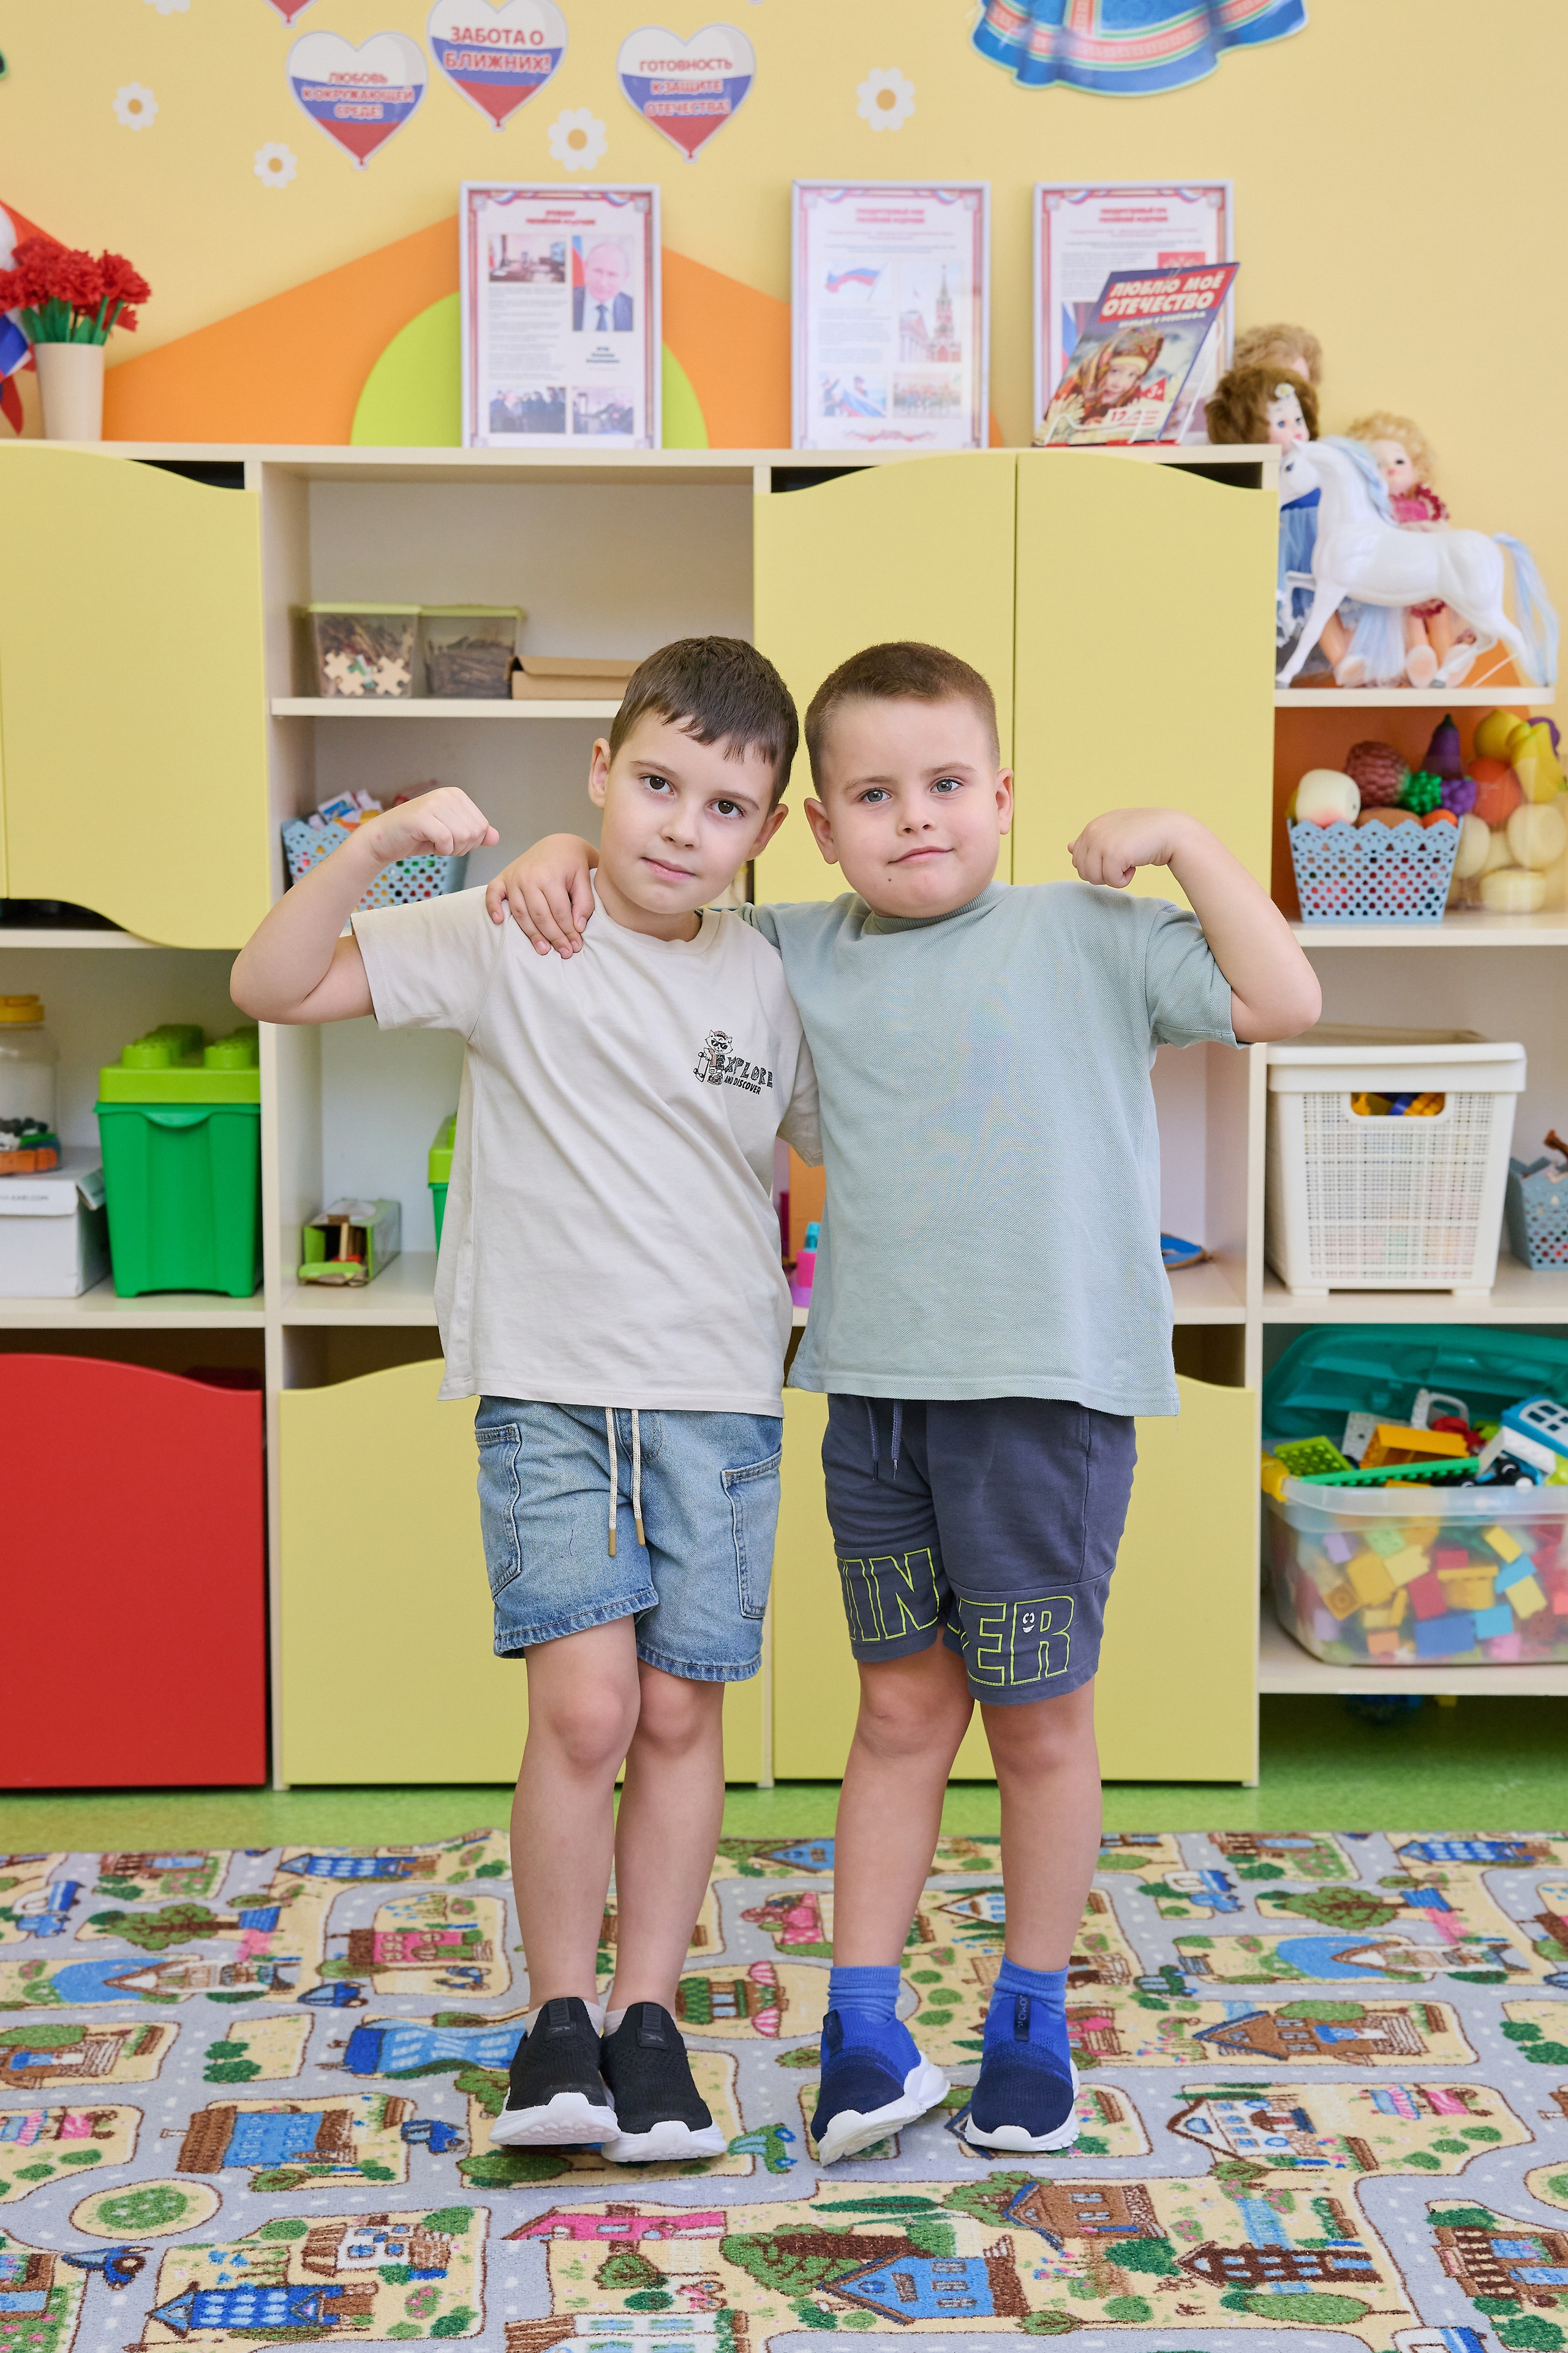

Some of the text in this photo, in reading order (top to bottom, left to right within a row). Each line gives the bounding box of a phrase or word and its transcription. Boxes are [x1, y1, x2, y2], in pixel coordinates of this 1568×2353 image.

[451, 26, 545, 46] ЗАБОТА О
[445, 51, 550, 72] БЛИЖНИХ!
[639, 58, 733, 72] ГОТОВНОСТЬ
[328, 71, 388, 85] ЛЮБОВЬ
[666, 80, 723, 95] ЗАЩИТЕ
[1109, 270, 1226, 298] ЛЮБЛЮ МОЁ
[1101, 290, 1215, 317] ОТЕЧЕСТВО
[723, 1075, 761, 1095] AND DISCOVER
